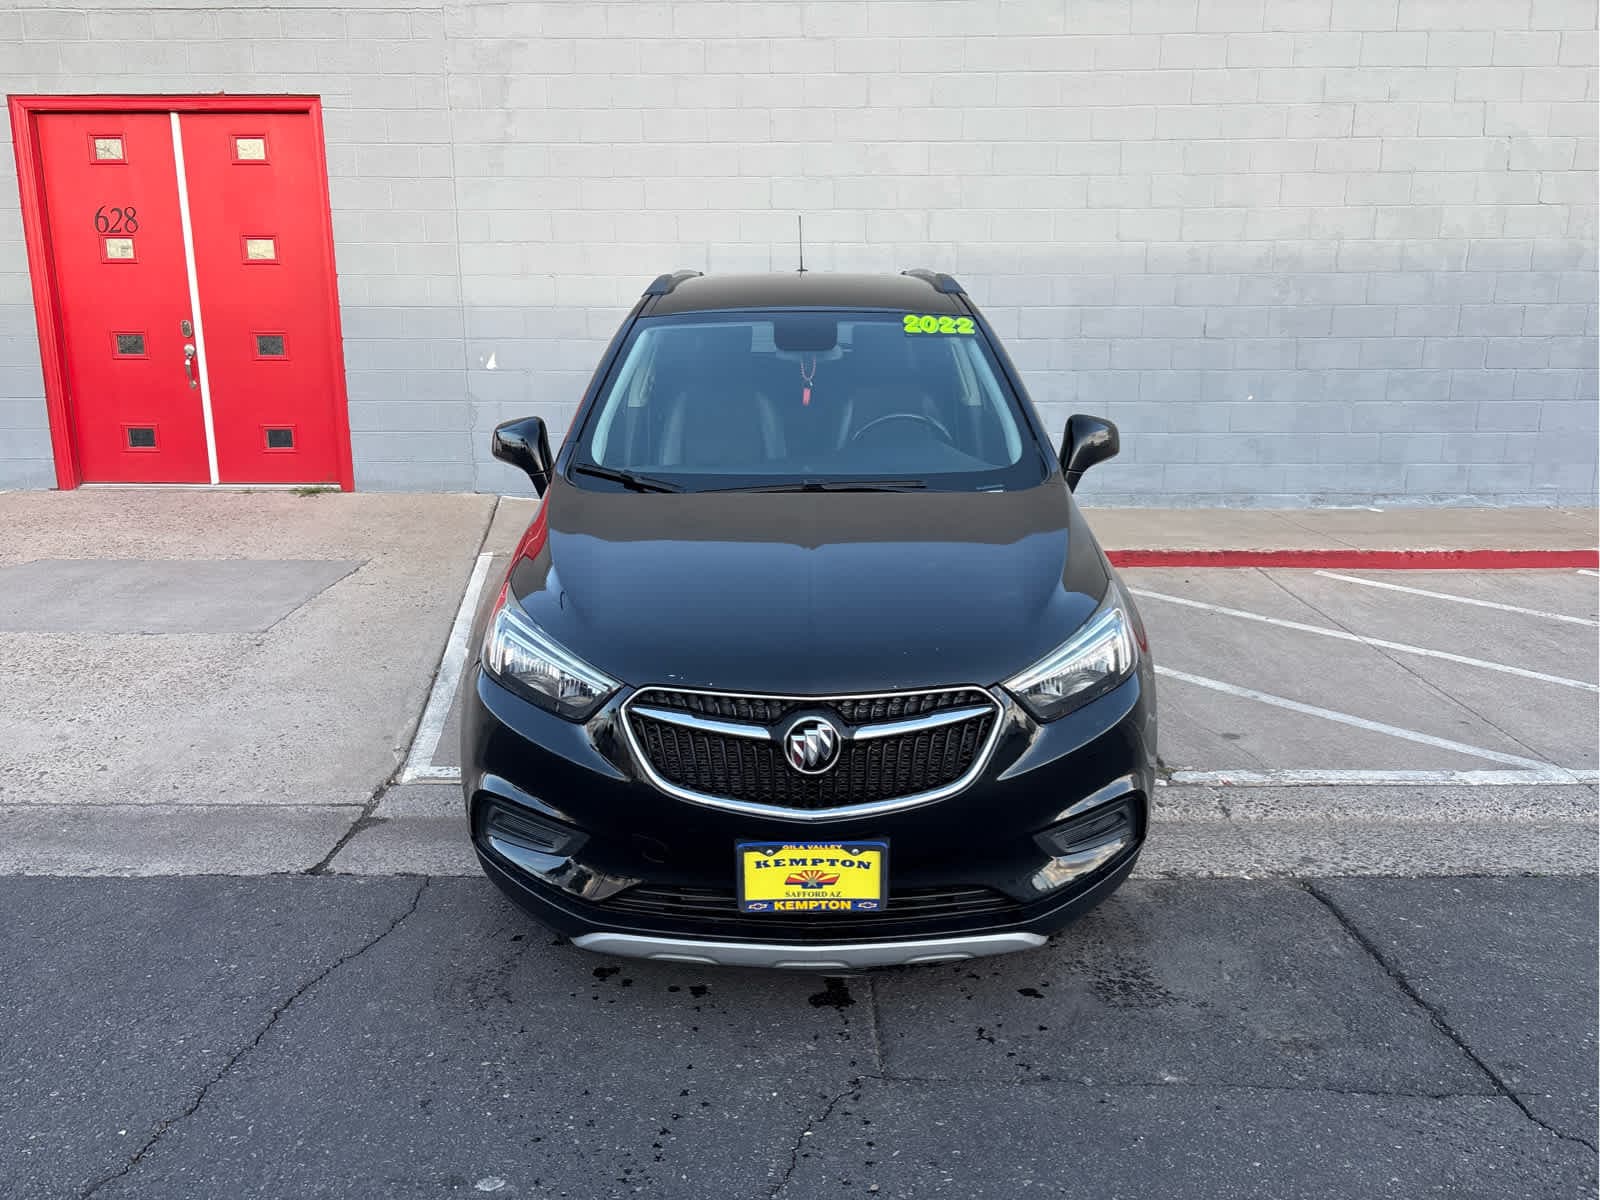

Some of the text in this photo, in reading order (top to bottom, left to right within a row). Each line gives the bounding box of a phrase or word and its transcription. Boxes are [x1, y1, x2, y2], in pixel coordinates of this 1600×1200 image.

[95, 205, 138, 233] 628
[903, 314, 976, 334] 2022
[755, 858, 872, 869] KEMPTON
[774, 901, 852, 910] KEMPTON
